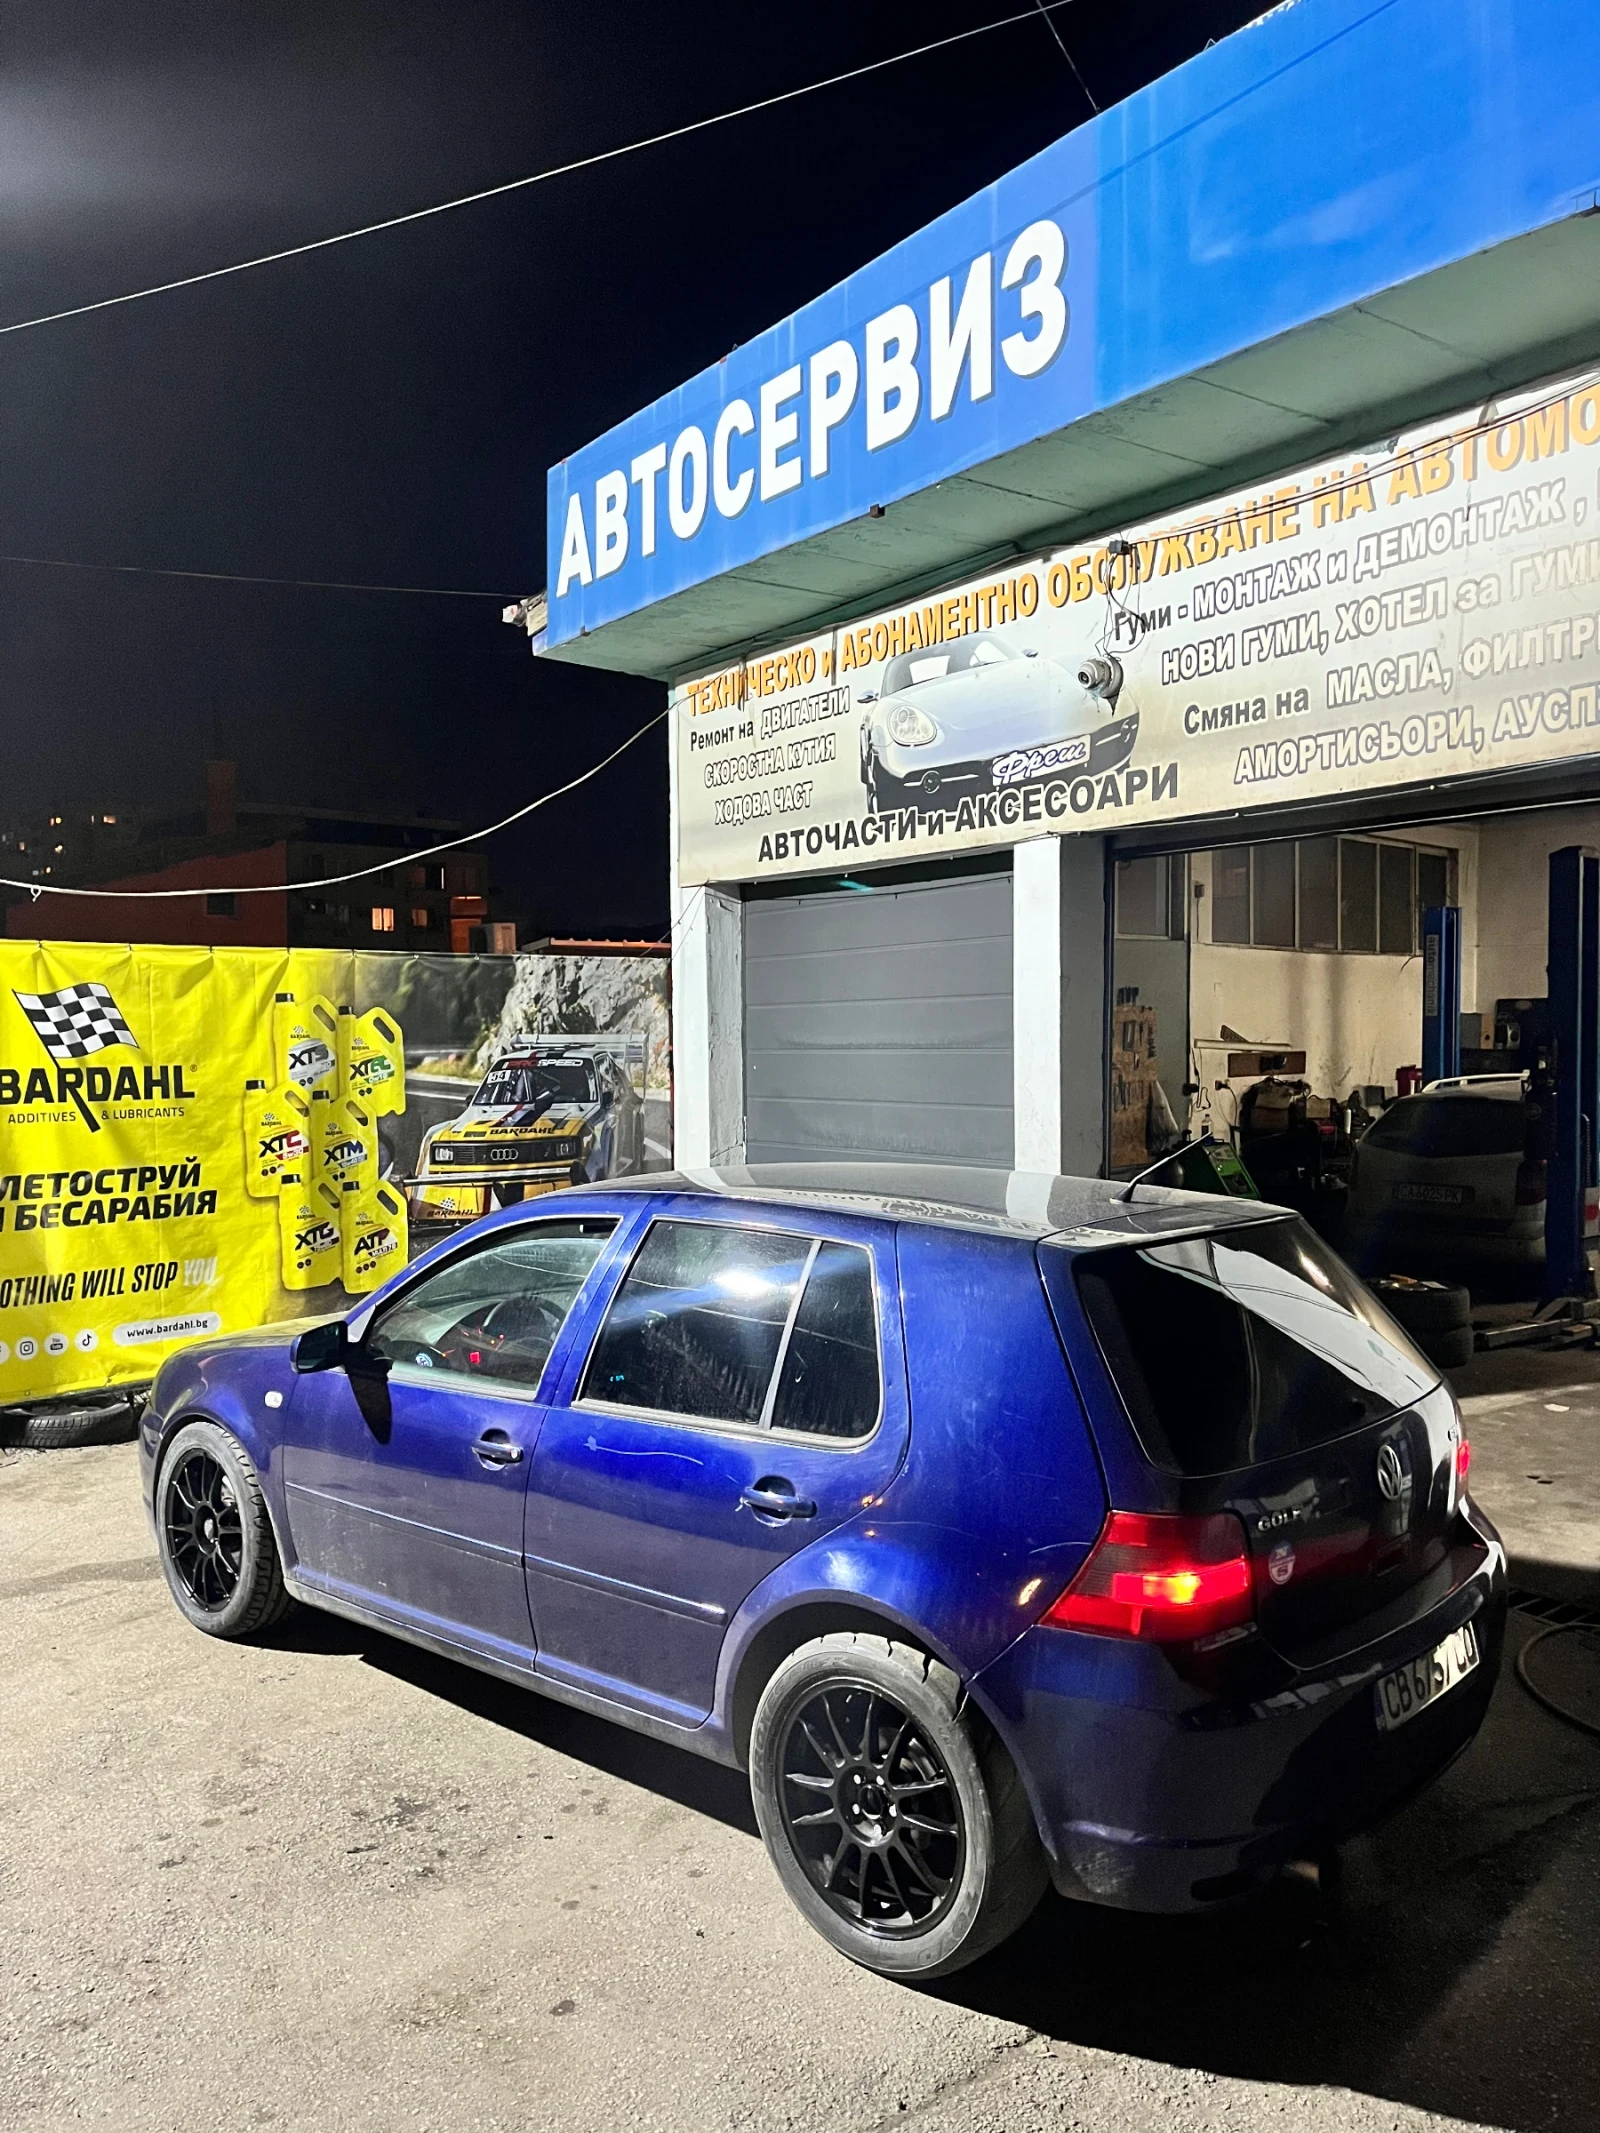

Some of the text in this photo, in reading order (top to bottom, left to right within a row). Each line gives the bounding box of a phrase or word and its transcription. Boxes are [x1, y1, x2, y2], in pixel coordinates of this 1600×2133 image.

[556, 219, 1067, 599] АВТОСЕРВИЗ
[1114, 605, 1172, 645] Гуми
[1193, 548, 1323, 621] МОНТАЖ
[1326, 550, 1349, 582] и
[1353, 476, 1568, 580] ДЕМОНТАЖ
[687, 648, 816, 716] ТЕХНИЧЕСКО
[841, 572, 1039, 671] АБОНАМЕНТНО
[1313, 462, 1378, 528] НА
[1162, 629, 1236, 685] НОВИ
[1241, 612, 1329, 667] ГУМИ,
[1334, 579, 1449, 642] ХОТЕЛ
[1457, 573, 1501, 613] за
[1184, 612, 1600, 735] Смяна на МАСЛА, ФИЛТР
[691, 685, 851, 751] Ремонт на ДВИГАТЕЛИ
[1234, 684, 1600, 785] АМОРТИСЬОРИ, АУСП
[704, 733, 836, 788] СКОРОСТНА КУТИЯ
[993, 740, 1087, 785] Фреш
[714, 780, 814, 826] ХОДОВА ЧАСТ
[1426, 936, 1437, 1016] automechanik
[0, 1065, 196, 1122] BARDAHL
[491, 1071, 506, 1082] 54
[8, 1106, 185, 1124] ADDITIVES & LUBRICANTS
[490, 1127, 555, 1137] BARDAHL
[259, 1130, 302, 1158] XTC
[324, 1140, 363, 1166] XTM
[0, 1156, 202, 1201] ЛЕТОСТРУЙ
[14, 1190, 218, 1232] БЕСАРАБИЯ
[295, 1221, 334, 1251] XTG
[354, 1227, 390, 1256] ATP
[82, 1267, 125, 1299] WILL
[131, 1261, 178, 1293] STOP
[183, 1256, 218, 1287] YOU
[127, 1318, 208, 1339] www.bardahl.bg
[1257, 1506, 1301, 1532] GOLF
[1384, 1669, 1413, 1719] CB
